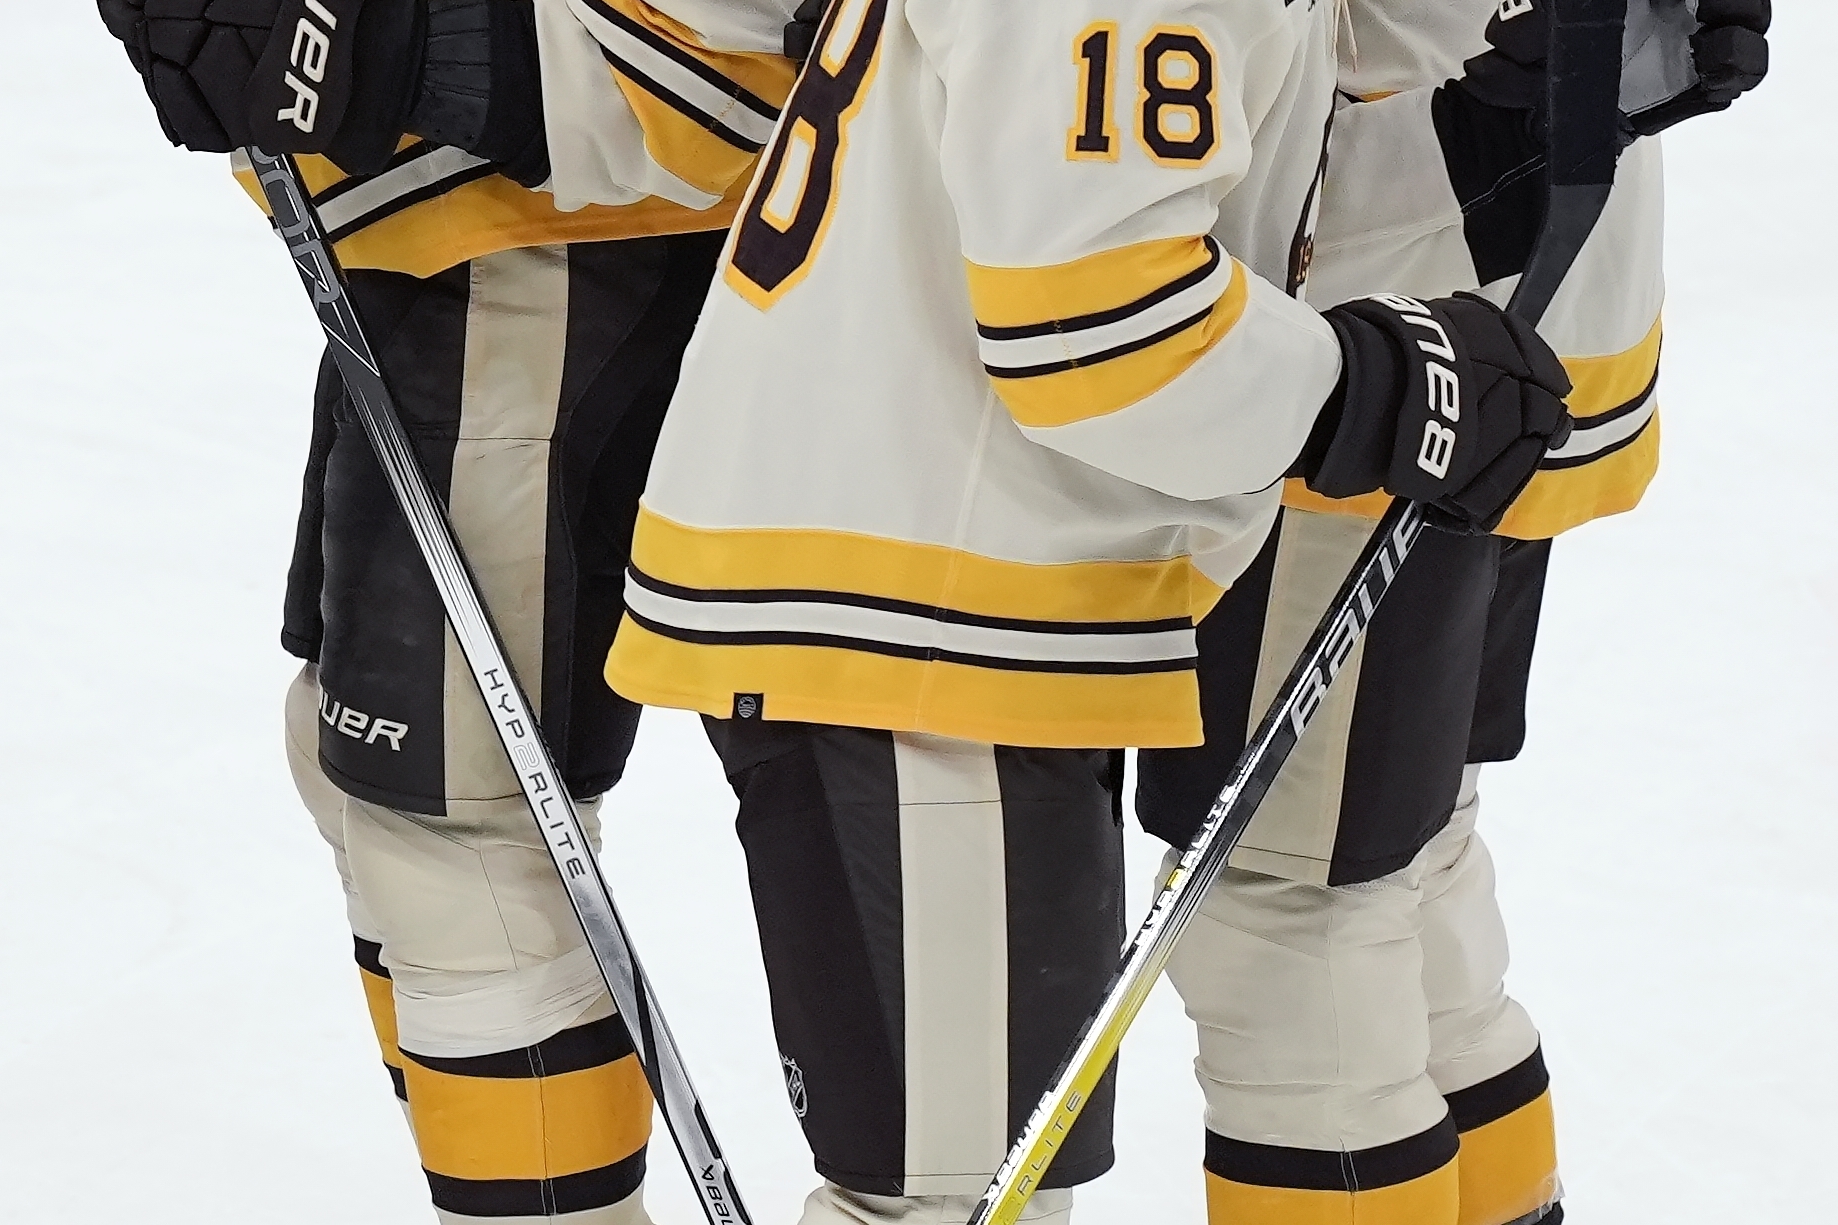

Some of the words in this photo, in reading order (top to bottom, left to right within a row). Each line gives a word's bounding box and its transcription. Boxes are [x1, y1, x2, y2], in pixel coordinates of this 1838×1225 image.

[1066, 20, 1220, 169] 18
[1369, 293, 1461, 480] BAUE
[319, 684, 409, 753] UER
